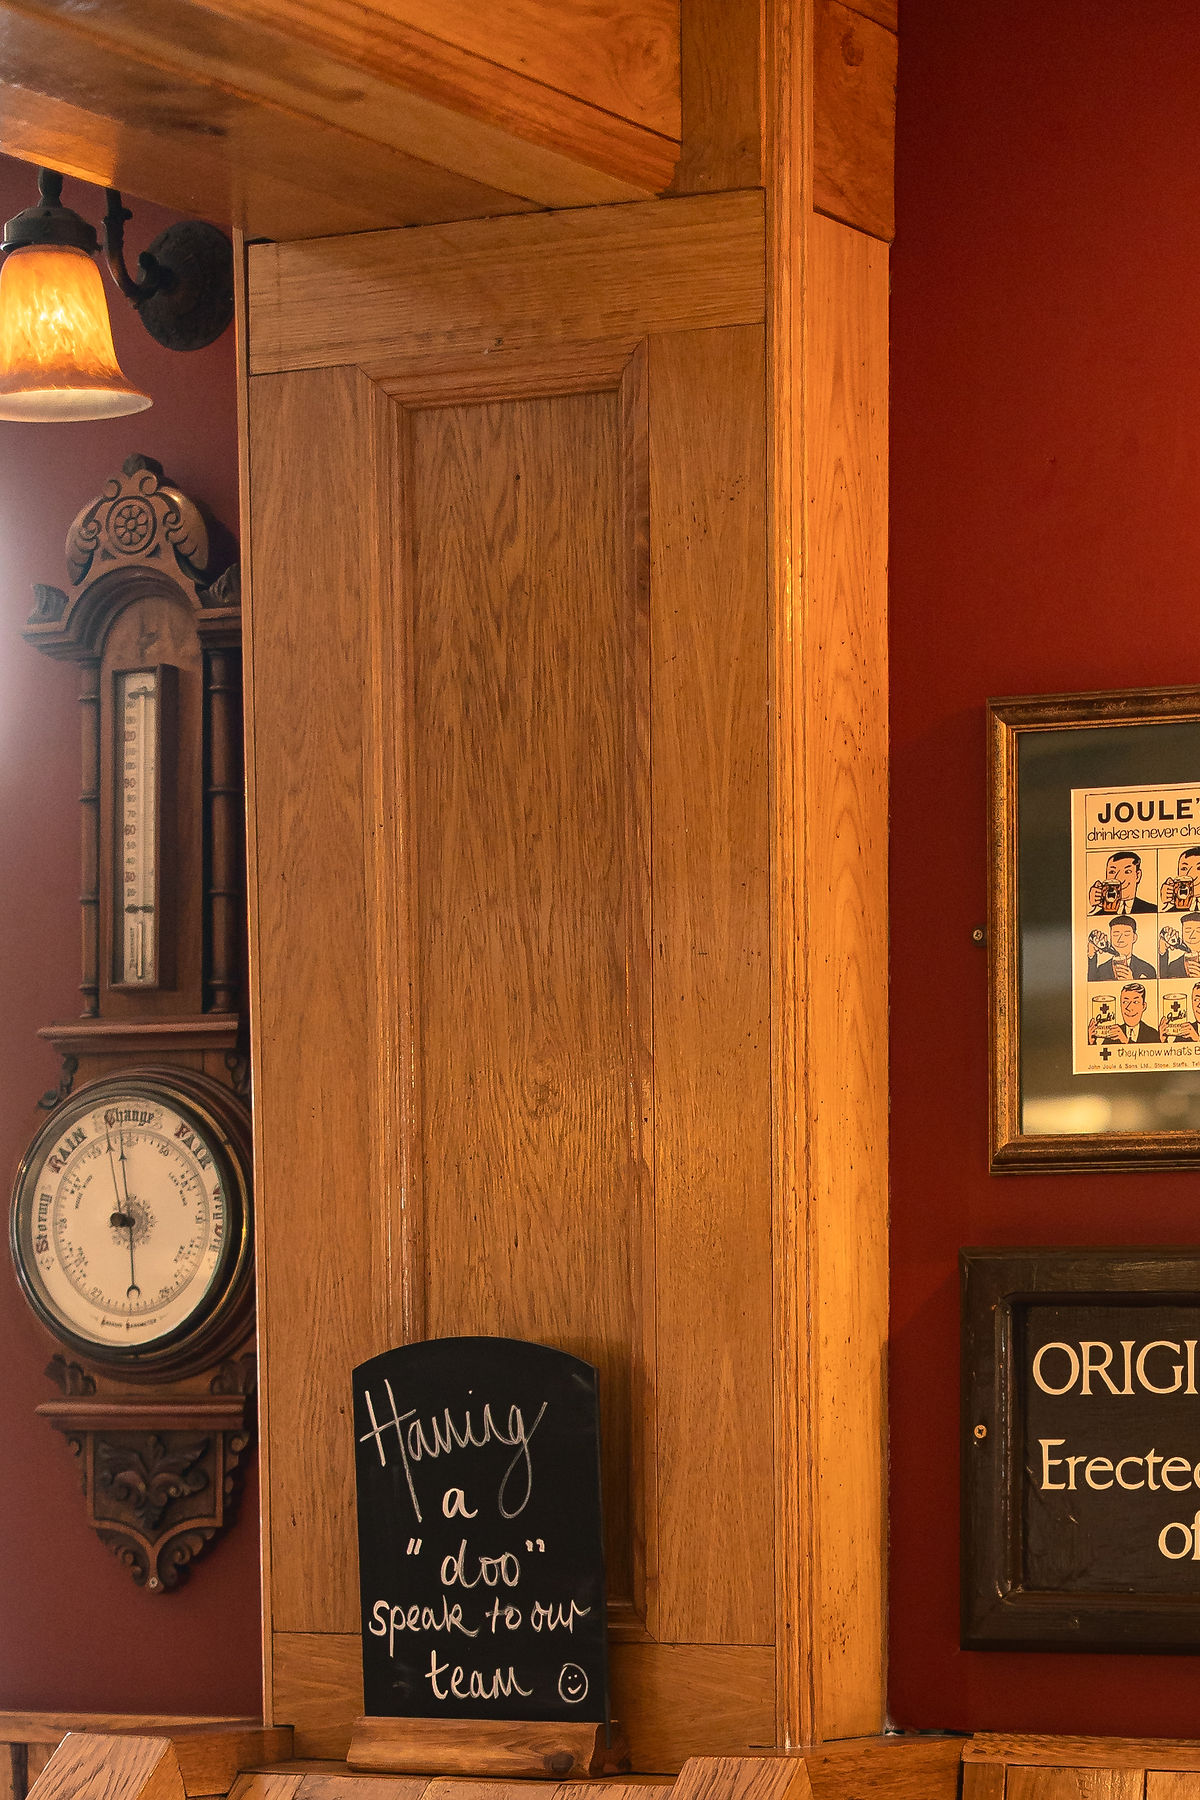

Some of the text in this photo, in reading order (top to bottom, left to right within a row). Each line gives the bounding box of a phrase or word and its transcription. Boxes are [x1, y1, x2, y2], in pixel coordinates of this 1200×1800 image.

[1087, 826, 1140, 842] drinkers
[1141, 827, 1179, 840] never
[1117, 1047, 1137, 1060] they
[1138, 1048, 1163, 1057] know
[1163, 1046, 1192, 1057] what's
[103, 1107, 155, 1129] Change
[359, 1378, 548, 1523] Having
[442, 1487, 479, 1519] a
[368, 1594, 593, 1659] speak to our
[424, 1649, 535, 1700] team
